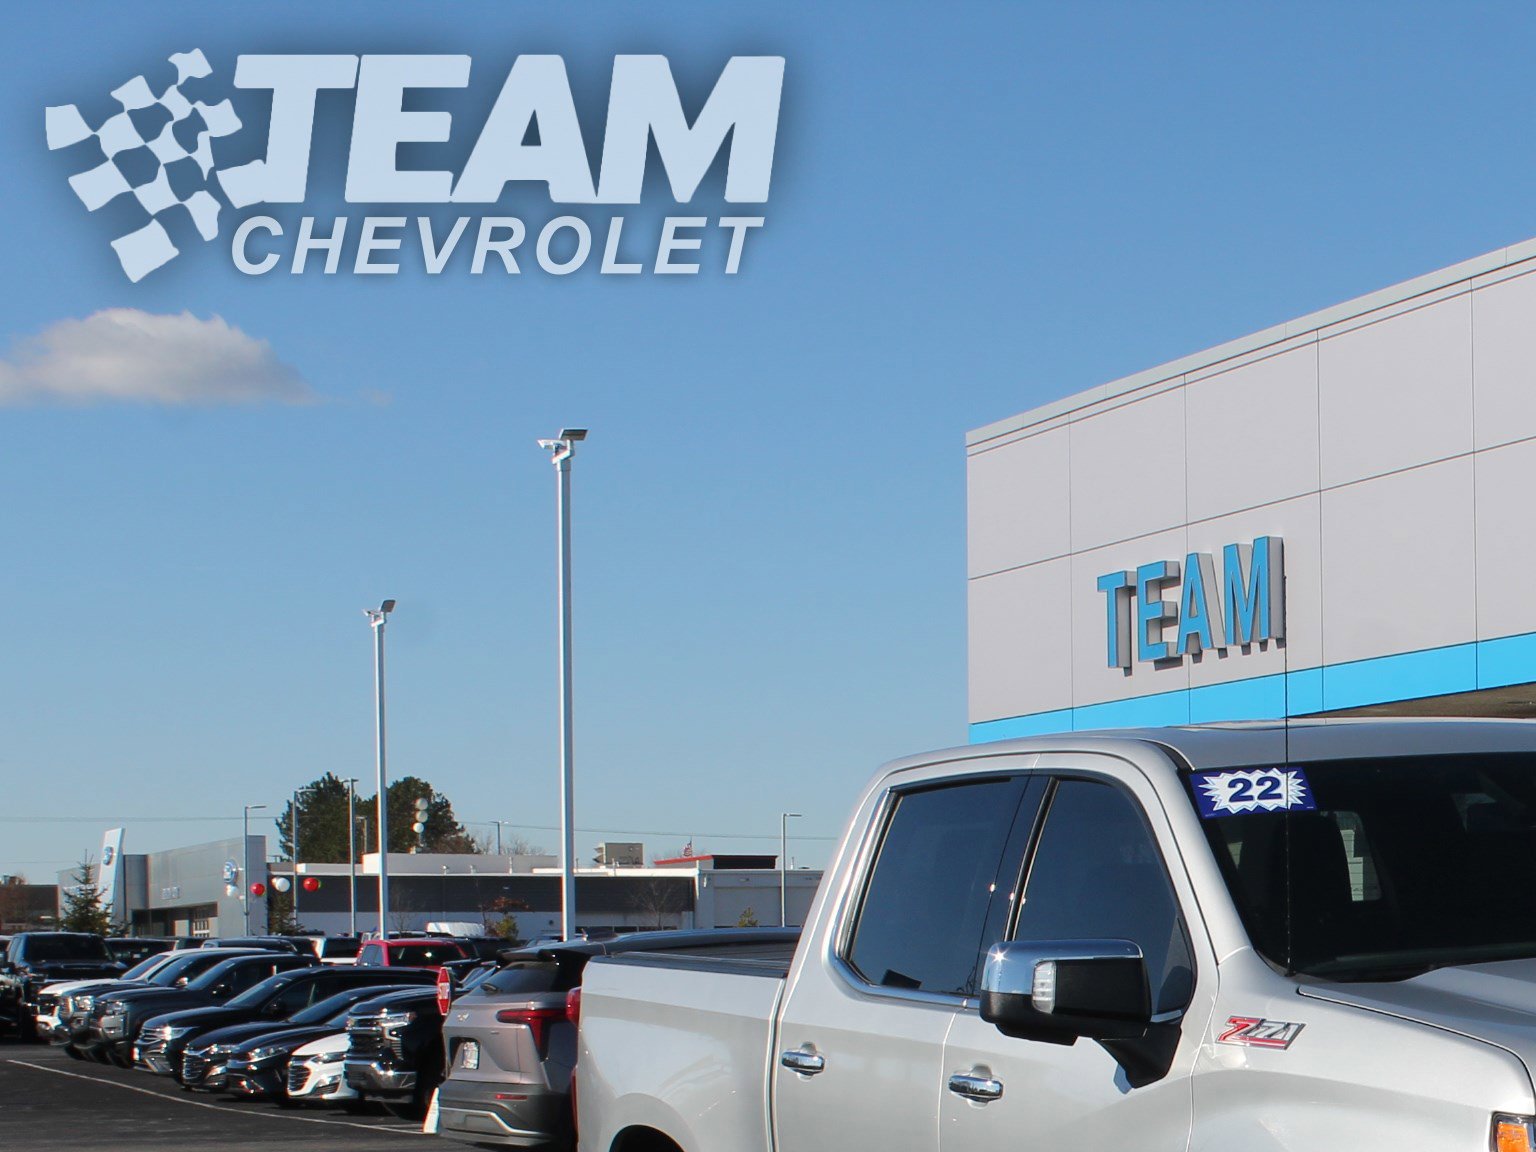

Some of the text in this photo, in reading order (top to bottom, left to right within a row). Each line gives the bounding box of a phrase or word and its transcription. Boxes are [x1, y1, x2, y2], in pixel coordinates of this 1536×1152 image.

[1097, 535, 1284, 669] TEAM
[1228, 775, 1283, 803] 22
[1215, 1015, 1307, 1051] Z71
